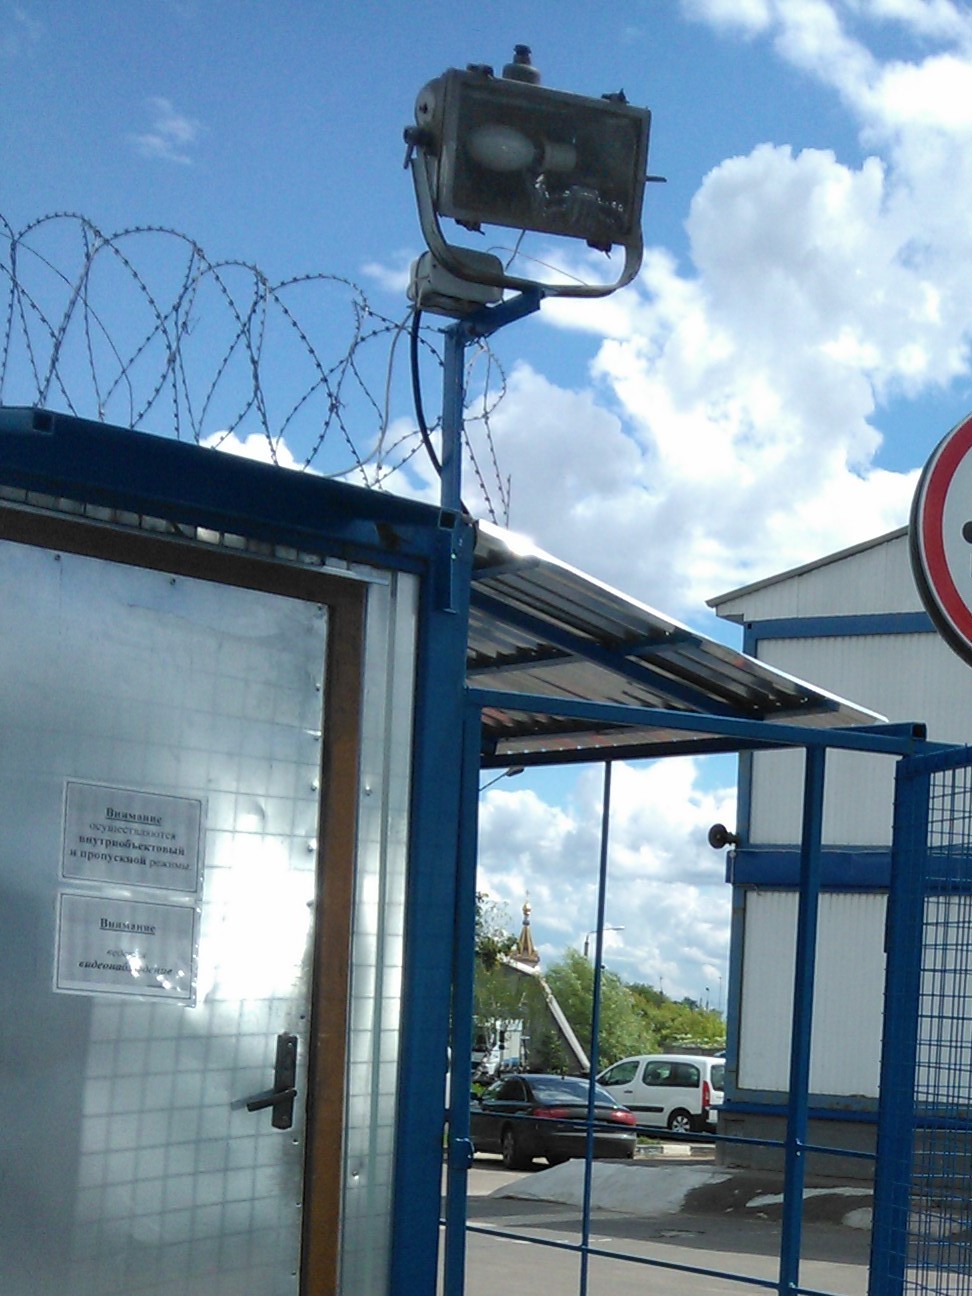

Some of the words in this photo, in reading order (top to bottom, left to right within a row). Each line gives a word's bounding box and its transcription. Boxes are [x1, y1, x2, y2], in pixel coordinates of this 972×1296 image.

[105, 807, 162, 825] Внимание
[80, 850, 146, 866] пропускной
[99, 917, 156, 935] Внимание
